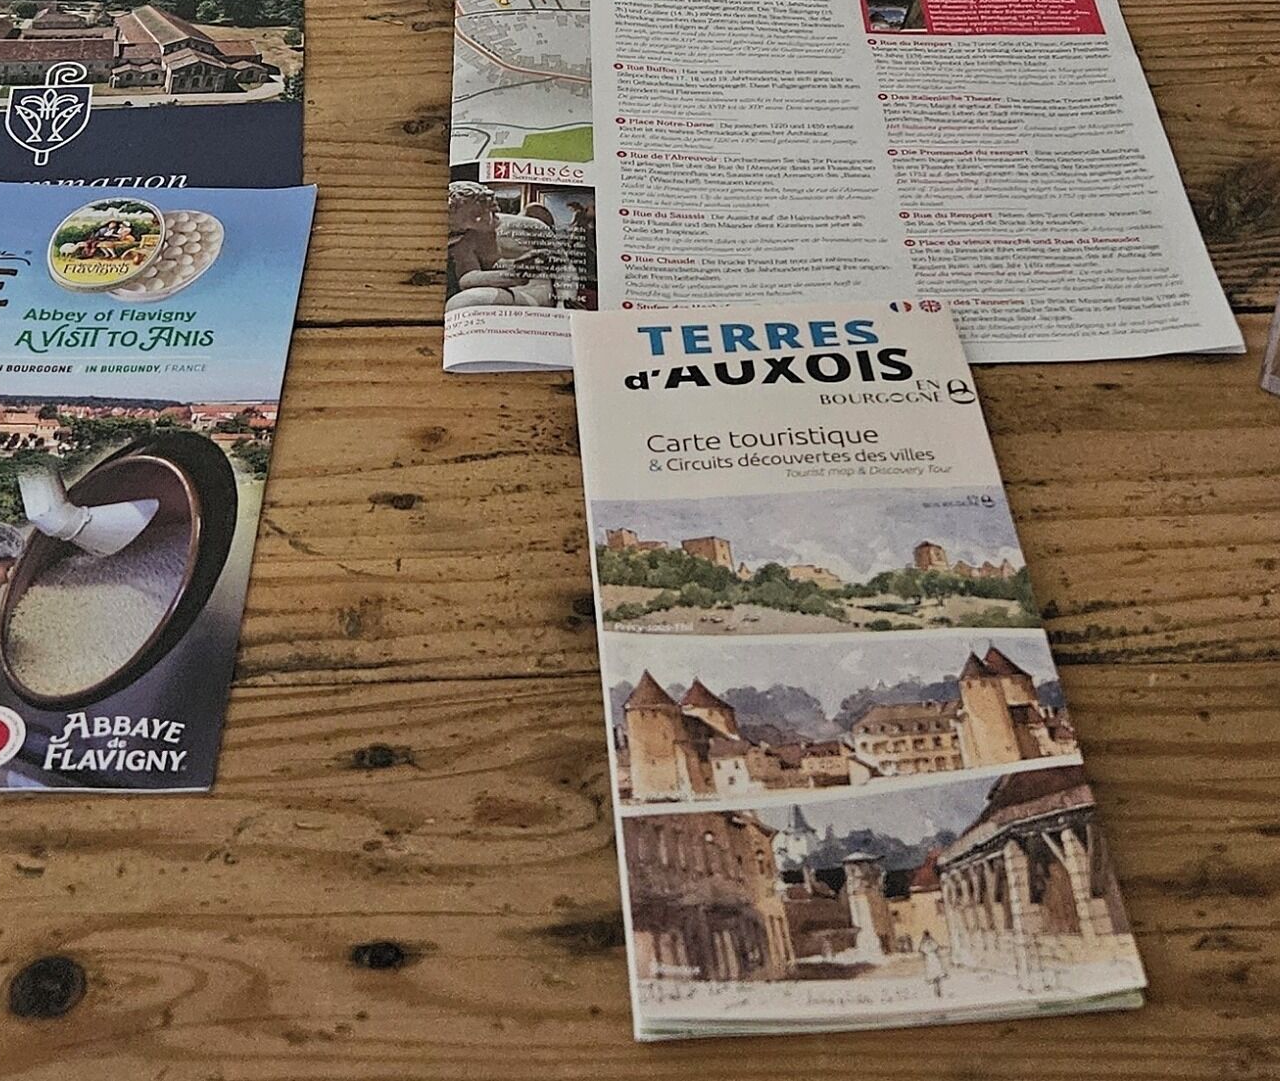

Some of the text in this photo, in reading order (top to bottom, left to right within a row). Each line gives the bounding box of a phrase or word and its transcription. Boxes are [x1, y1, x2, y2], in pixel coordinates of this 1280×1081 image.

[512, 162, 584, 179] Musée
[23, 308, 197, 323] Abbey of Flavigny
[637, 320, 880, 357] TERRES
[623, 347, 914, 391] d'AUXOIS
[916, 379, 941, 391] EN
[819, 391, 943, 406] BOURGOGNE
[646, 426, 880, 454] Carte touristique
[649, 447, 935, 473] & Circuits découvertes des villes
[50, 711, 186, 744] ABBAYE
[43, 741, 188, 771] FLAVIGNY
[107, 737, 128, 749] de
